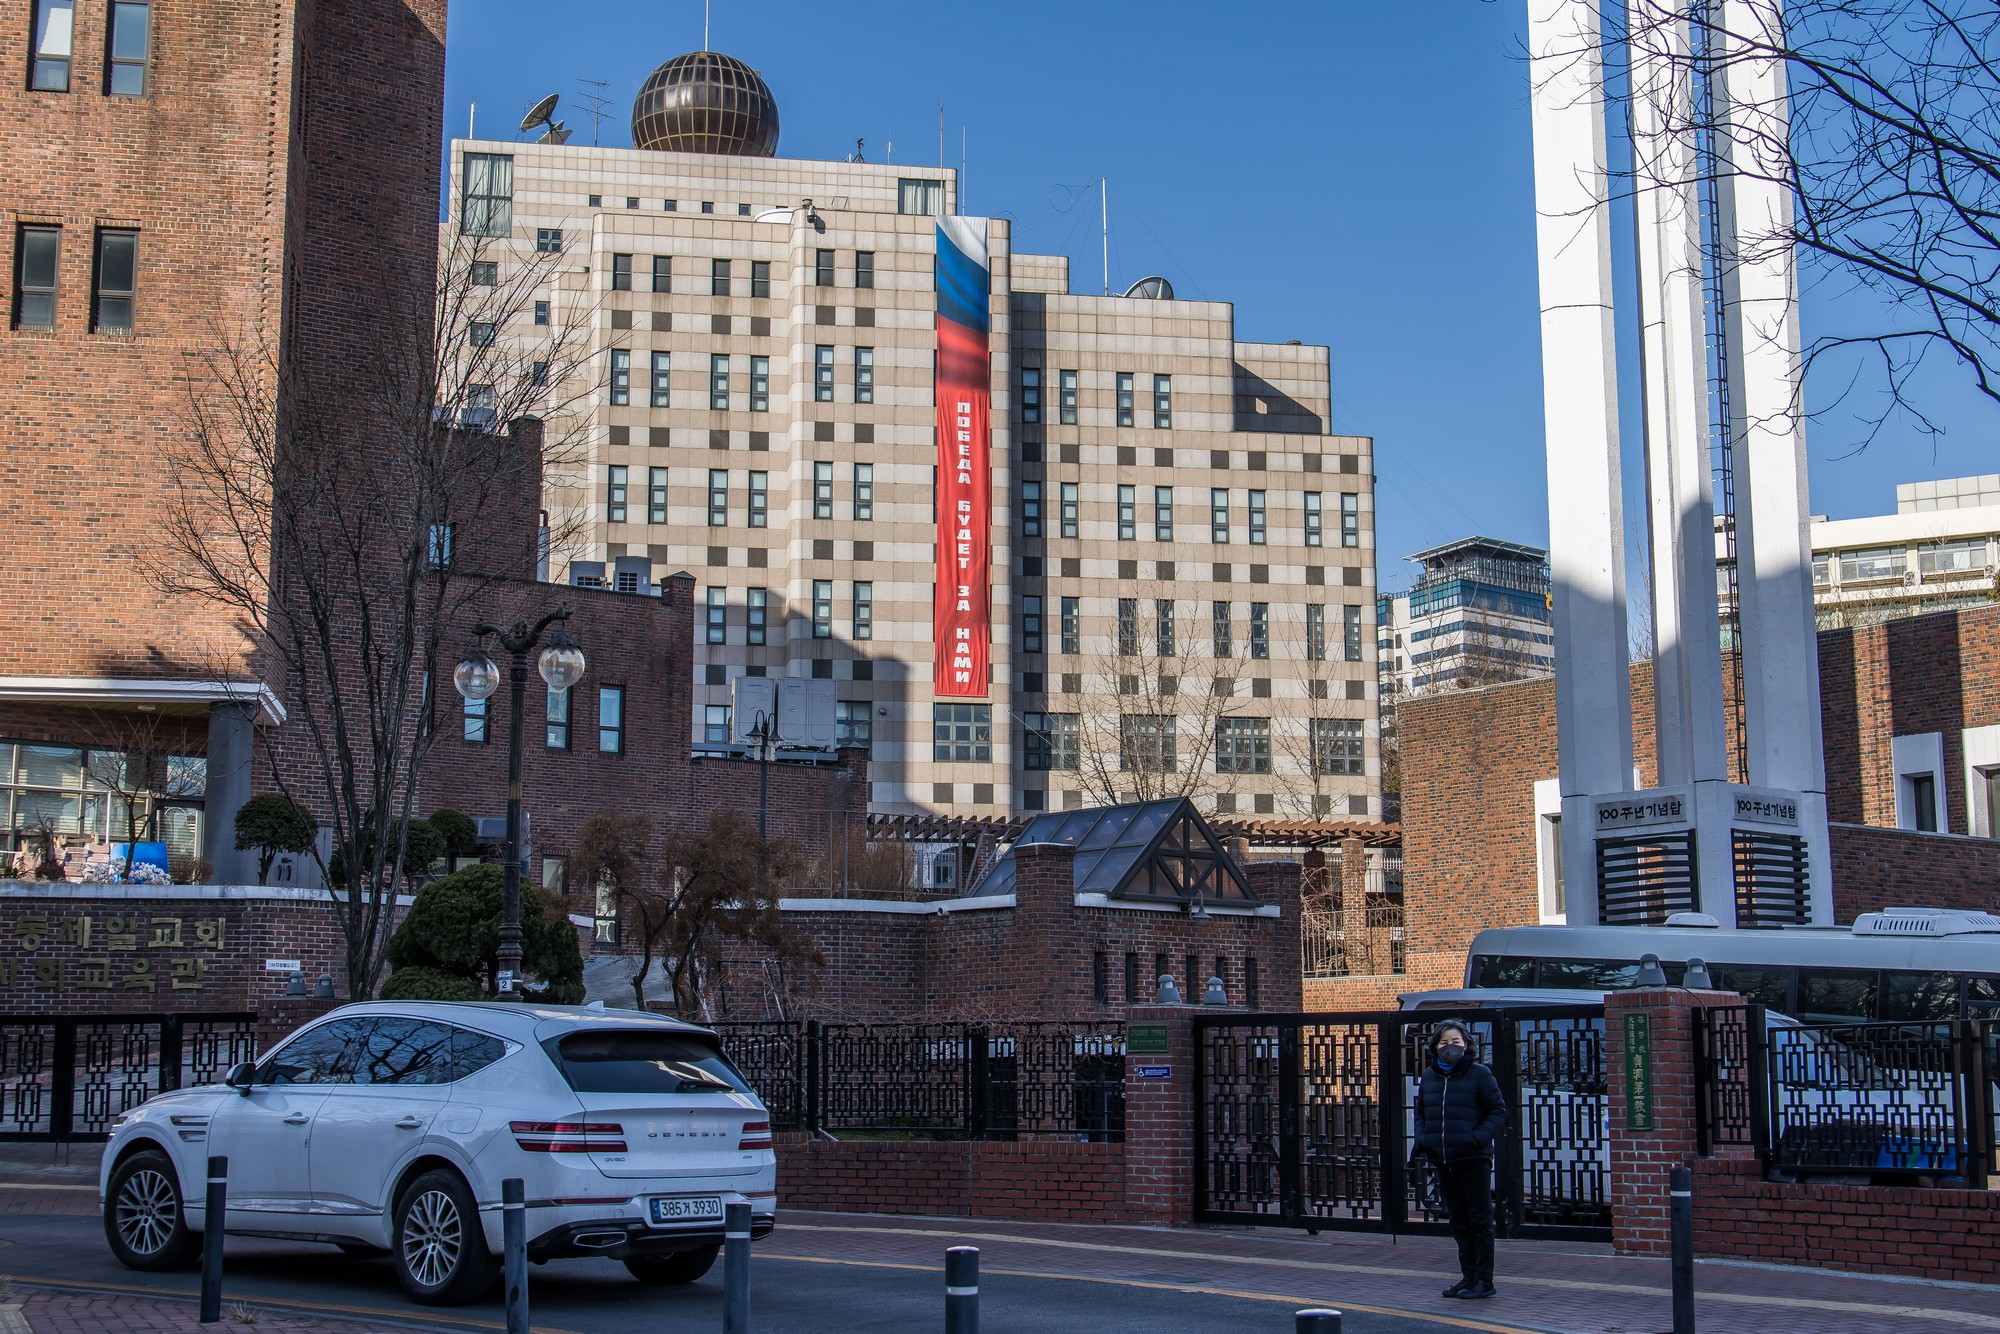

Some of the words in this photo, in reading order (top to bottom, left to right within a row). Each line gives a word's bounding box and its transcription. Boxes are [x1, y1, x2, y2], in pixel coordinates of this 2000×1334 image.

[956, 402, 972, 484] ПОБЕДА
[956, 500, 972, 569] БУДЕТ
[956, 585, 971, 611] ЗА
[953, 628, 972, 683] НАМИ
[501, 980, 508, 989] 2
[692, 1199, 719, 1215] 3930
